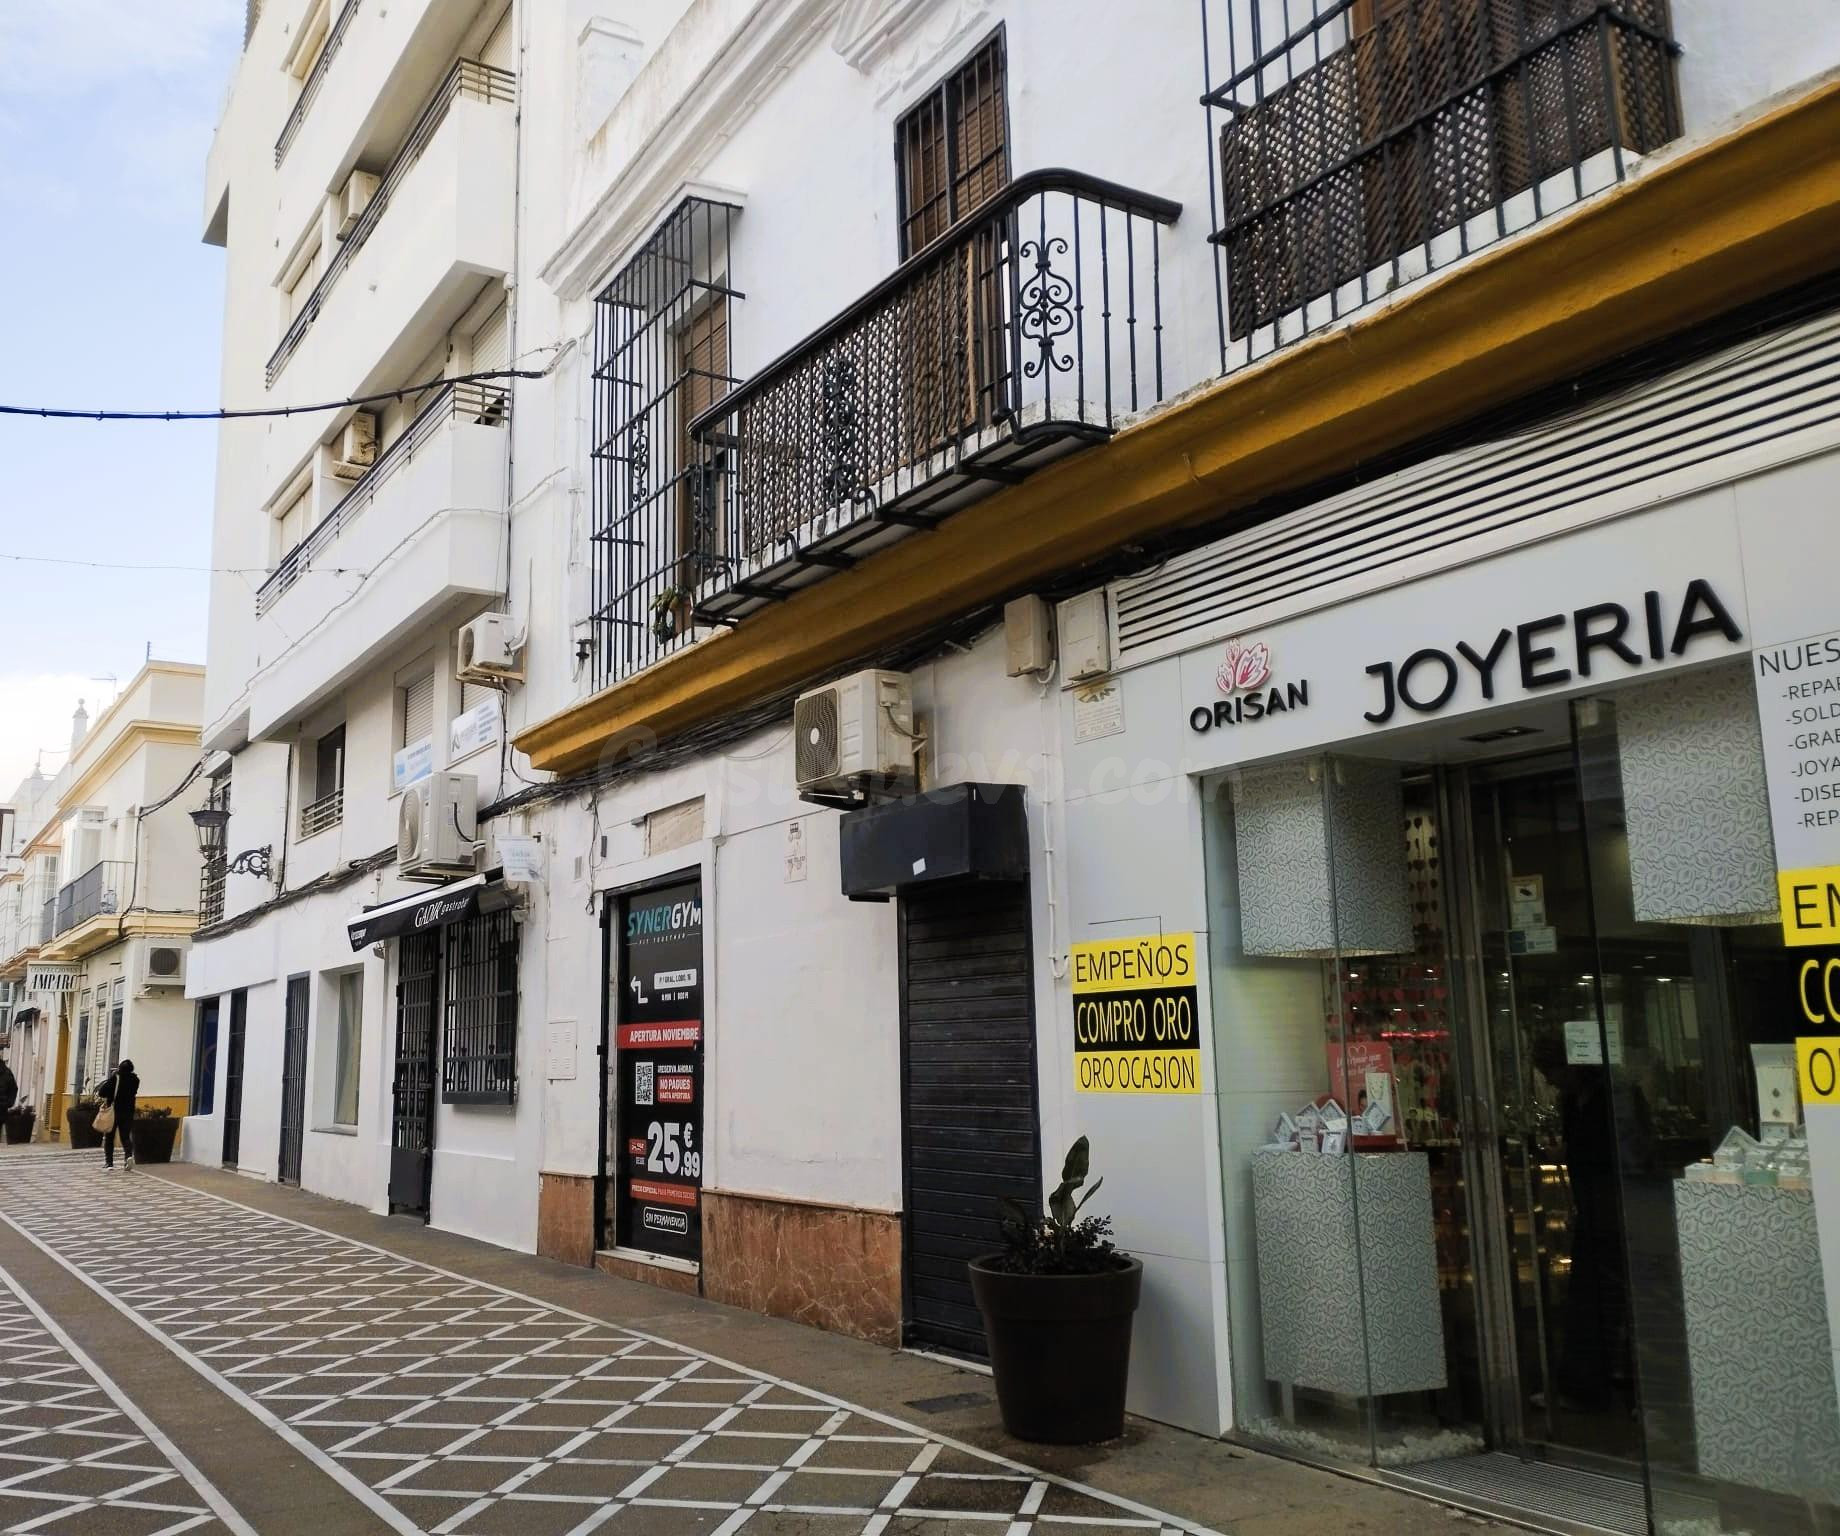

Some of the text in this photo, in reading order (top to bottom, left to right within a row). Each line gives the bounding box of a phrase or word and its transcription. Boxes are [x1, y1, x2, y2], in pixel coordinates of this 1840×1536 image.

[1363, 578, 1743, 724] JOYERIA
[1189, 679, 1308, 732] ORISAN
[627, 900, 702, 936] SYNERGYM
[1076, 941, 1189, 983] EMPEÑOS
[629, 1027, 699, 1042] APERTURA NOVIEMBRE
[1077, 995, 1191, 1043] COMPRO ORO
[659, 1079, 691, 1090] NO PAGUES
[1080, 1055, 1195, 1089] ORO OCASION
[647, 1121, 680, 1174] 25
[683, 1122, 693, 1148] €
[645, 1212, 654, 1224] SIN
